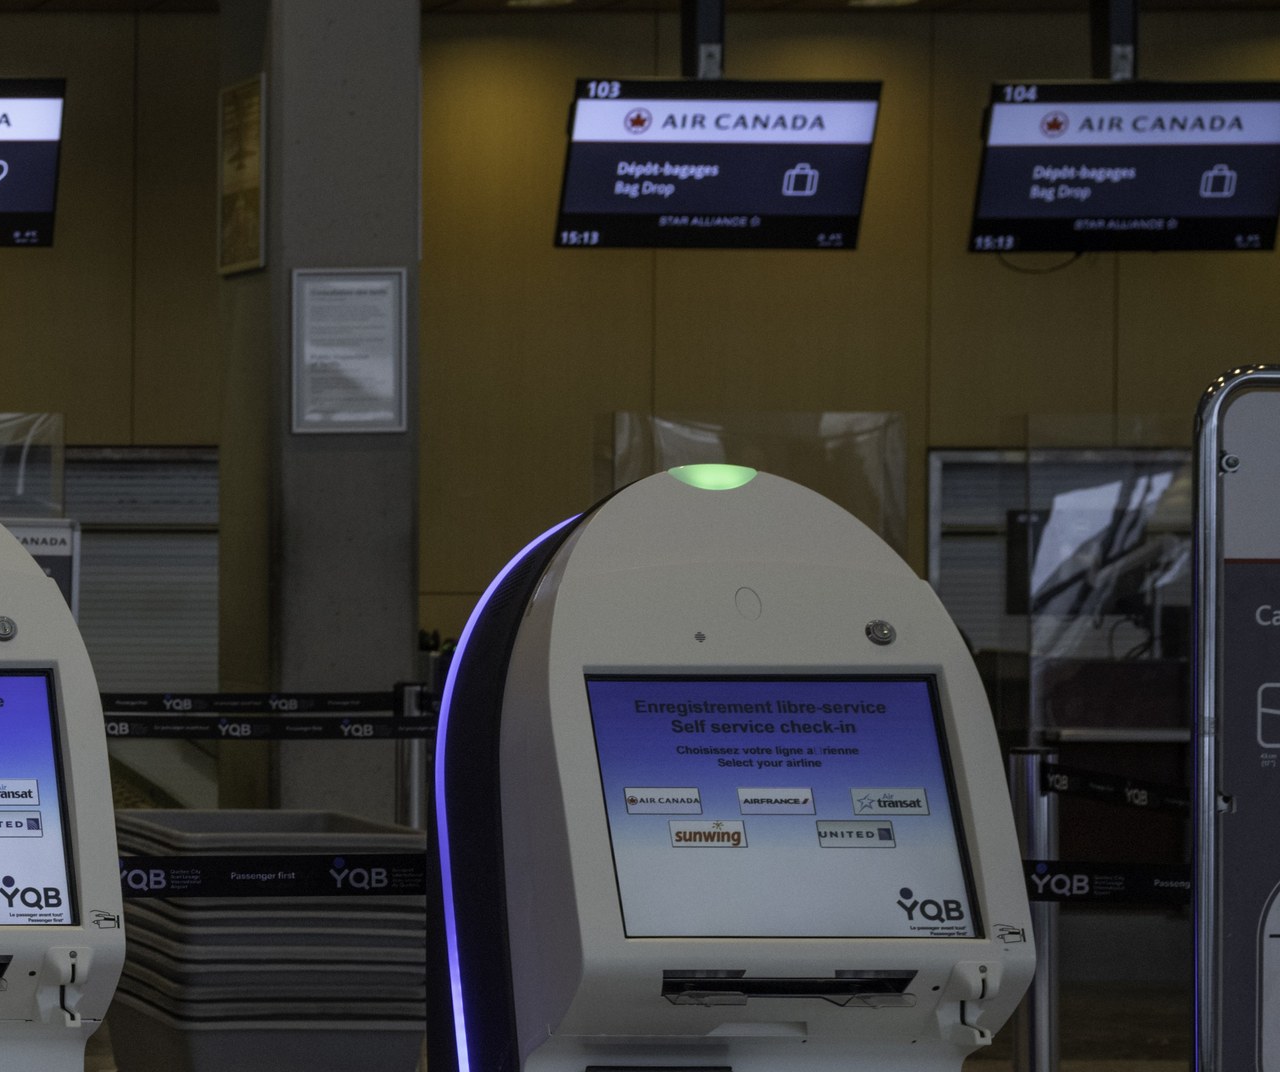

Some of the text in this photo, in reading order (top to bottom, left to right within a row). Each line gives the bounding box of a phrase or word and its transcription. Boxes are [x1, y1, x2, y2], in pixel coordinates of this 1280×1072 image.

[588, 81, 621, 98] 103
[1003, 85, 1038, 102] 104
[661, 113, 826, 131] AIR CANADA
[1078, 115, 1245, 132] AIR CANADA
[617, 161, 719, 179] Dépôt-bagages
[614, 181, 675, 198] Bag Drop
[1030, 185, 1091, 201] Bag Drop
[635, 700, 886, 716] Enregistrement libre-service
[671, 720, 856, 734] Self service check-in
[878, 797, 922, 808] transat
[675, 829, 741, 846] sunwing
[818, 831, 875, 839] UNITED
[231, 872, 275, 881] Passenger
[329, 868, 388, 890] YQB
[1031, 874, 1089, 896] YQB
[0, 887, 62, 910] YQB
[897, 899, 964, 923] YQB
